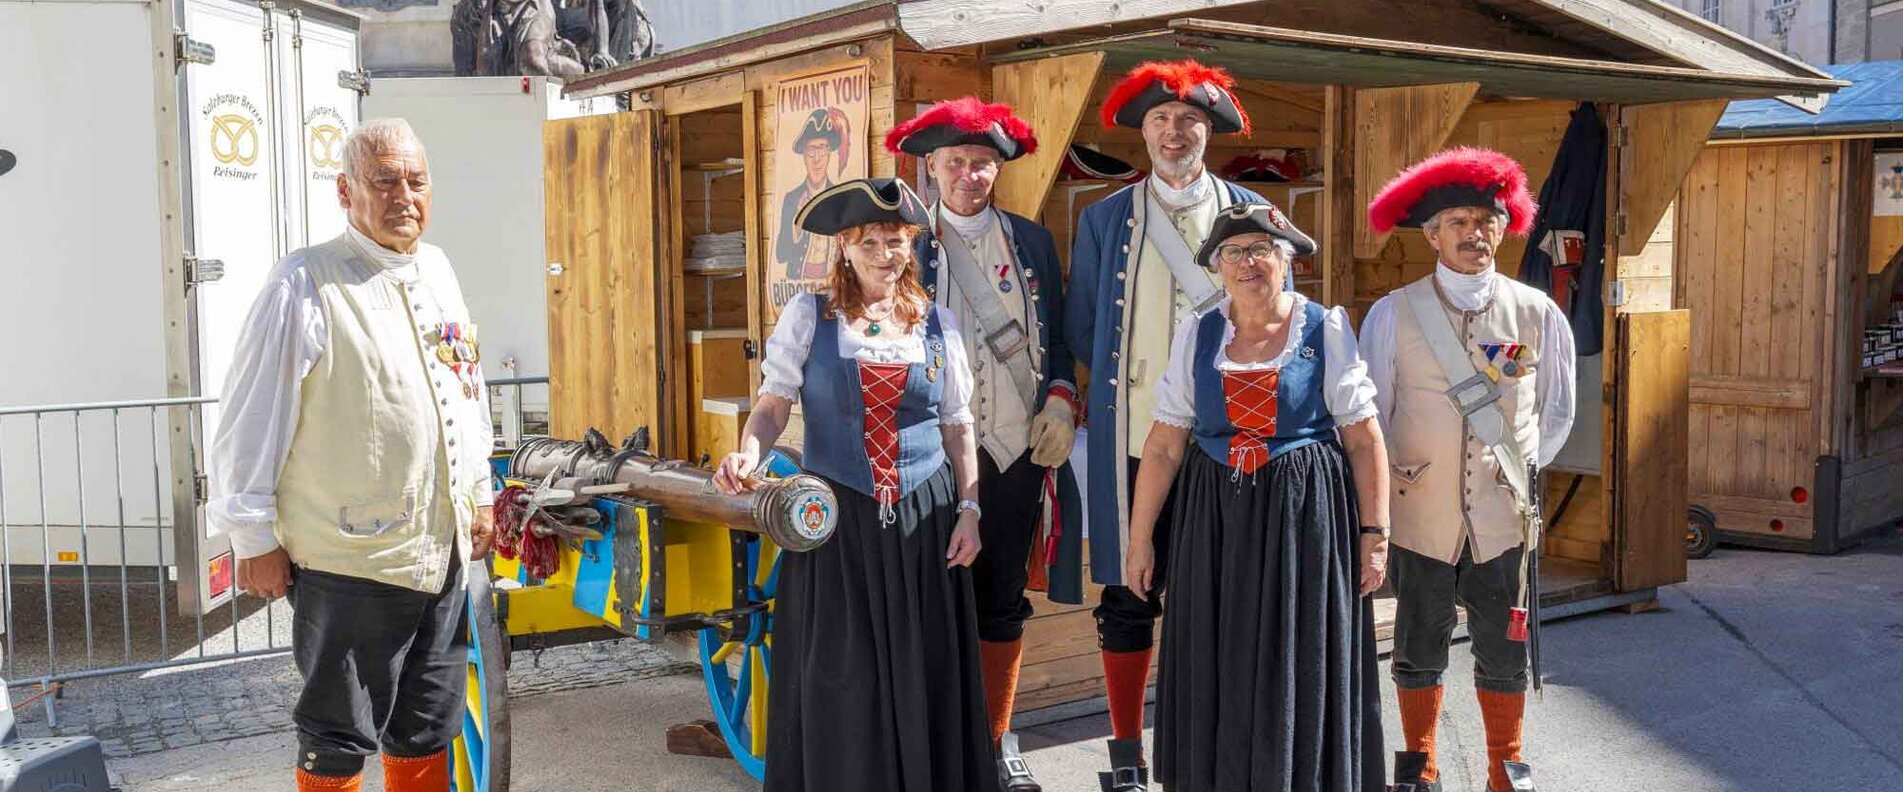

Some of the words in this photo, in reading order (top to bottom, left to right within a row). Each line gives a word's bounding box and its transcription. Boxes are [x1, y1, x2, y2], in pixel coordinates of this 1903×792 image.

[781, 88, 786, 114] I
[788, 80, 829, 113] WANT
[833, 74, 863, 105] YOU
[202, 93, 240, 120] Salzburger
[213, 166, 258, 181] Reisinger
[312, 171, 338, 181] Reisin
